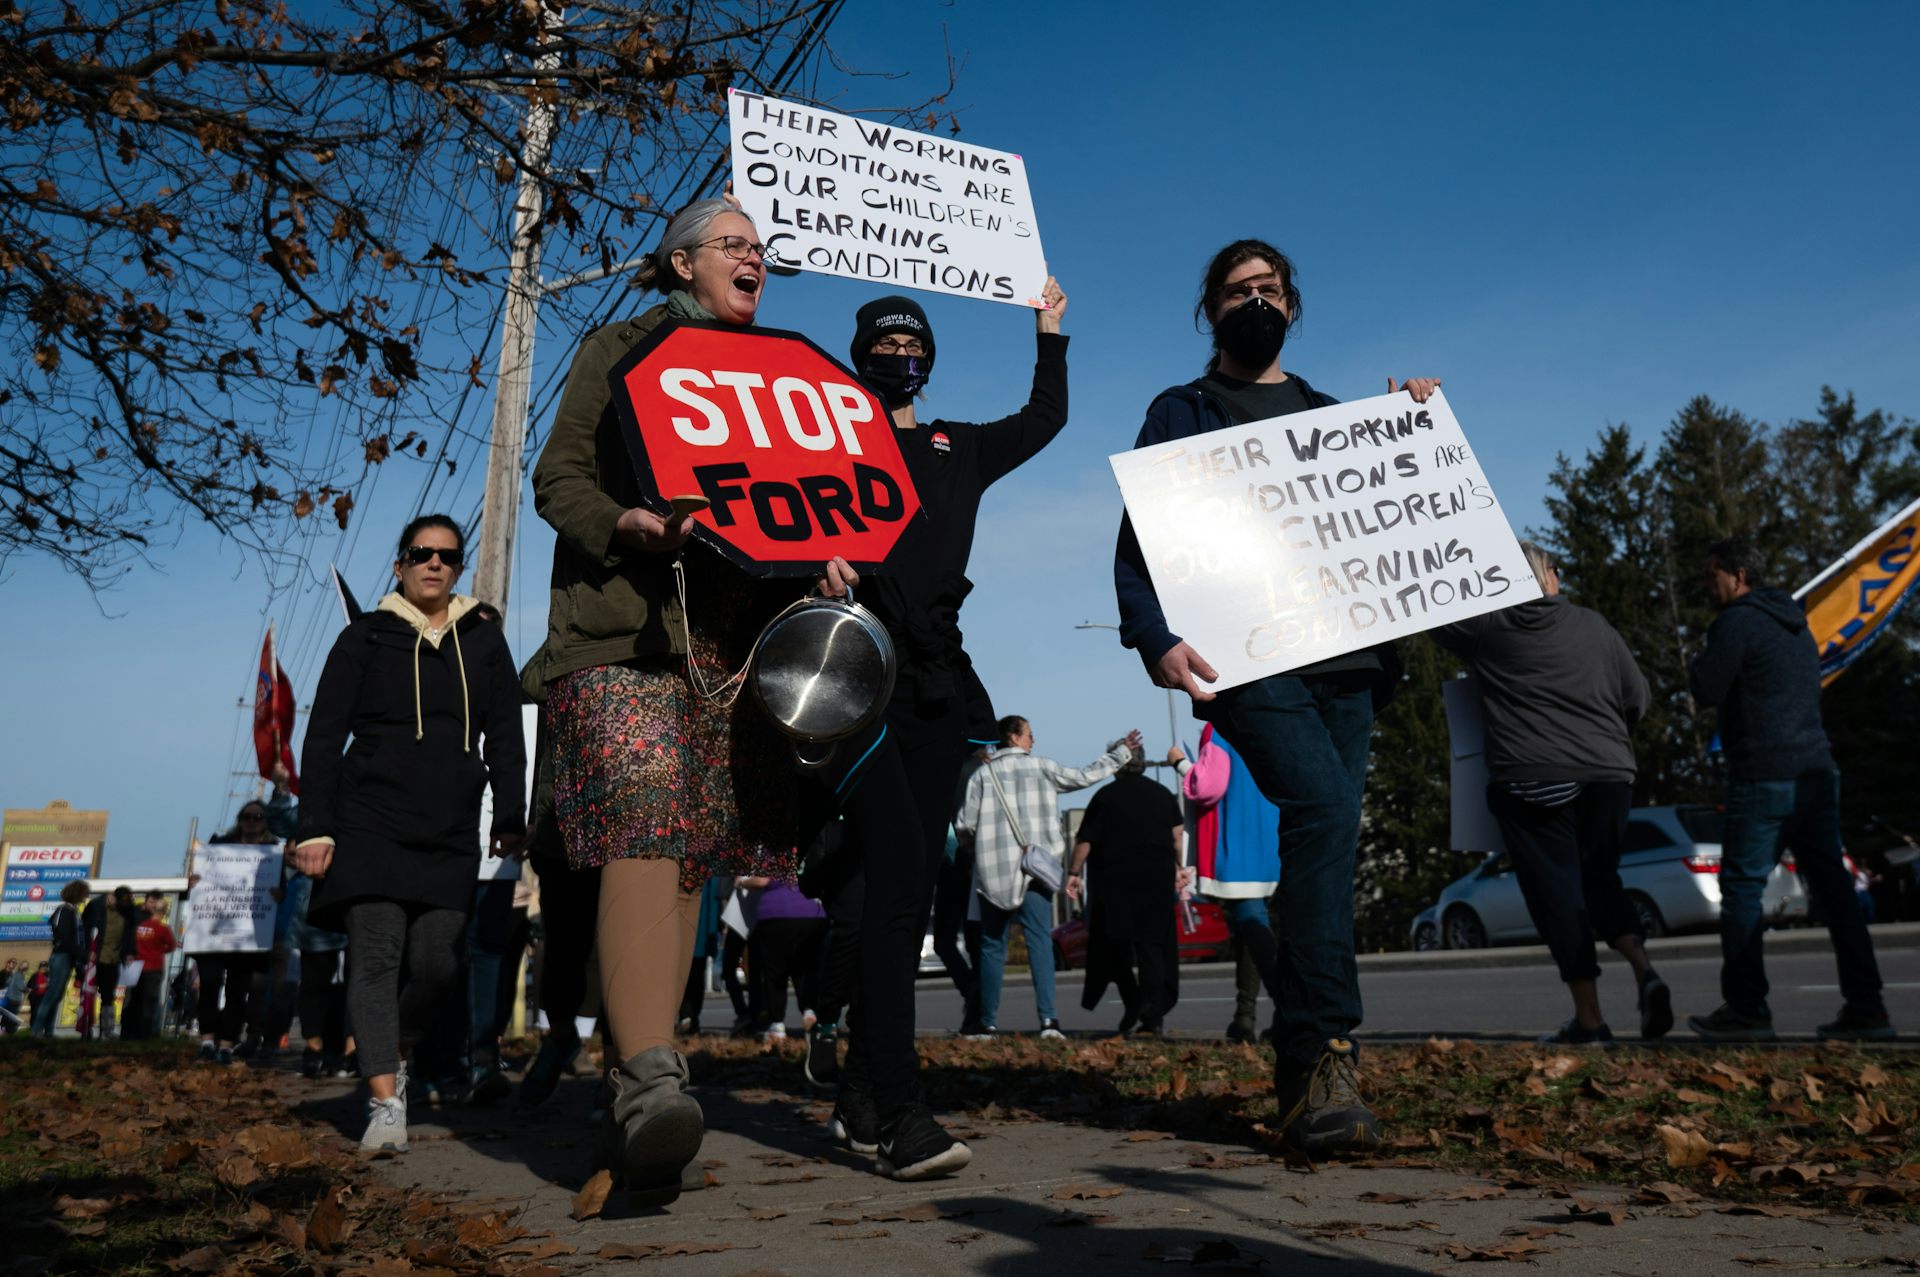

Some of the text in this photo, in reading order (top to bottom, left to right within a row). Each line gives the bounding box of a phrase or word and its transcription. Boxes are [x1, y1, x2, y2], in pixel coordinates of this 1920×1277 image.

[734, 91, 1012, 176] THEIR WORKING
[742, 131, 1015, 205] CONDITIONS ARE
[747, 162, 1031, 238] OUR CHILDREN'S
[771, 199, 949, 254] LEARNING
[766, 233, 1014, 298] CONDITIONS
[659, 367, 874, 456] STOP
[1152, 410, 1434, 488] THEIR WORKING
[1435, 443, 1470, 469] ARE
[692, 462, 905, 542] FORD
[1278, 478, 1495, 551] CHILDREN'S
[1245, 565, 1510, 662] CONDITIONS
[1263, 539, 1474, 620] LEARNING
[19, 848, 83, 861] metro
[5, 889, 27, 897] BMO
